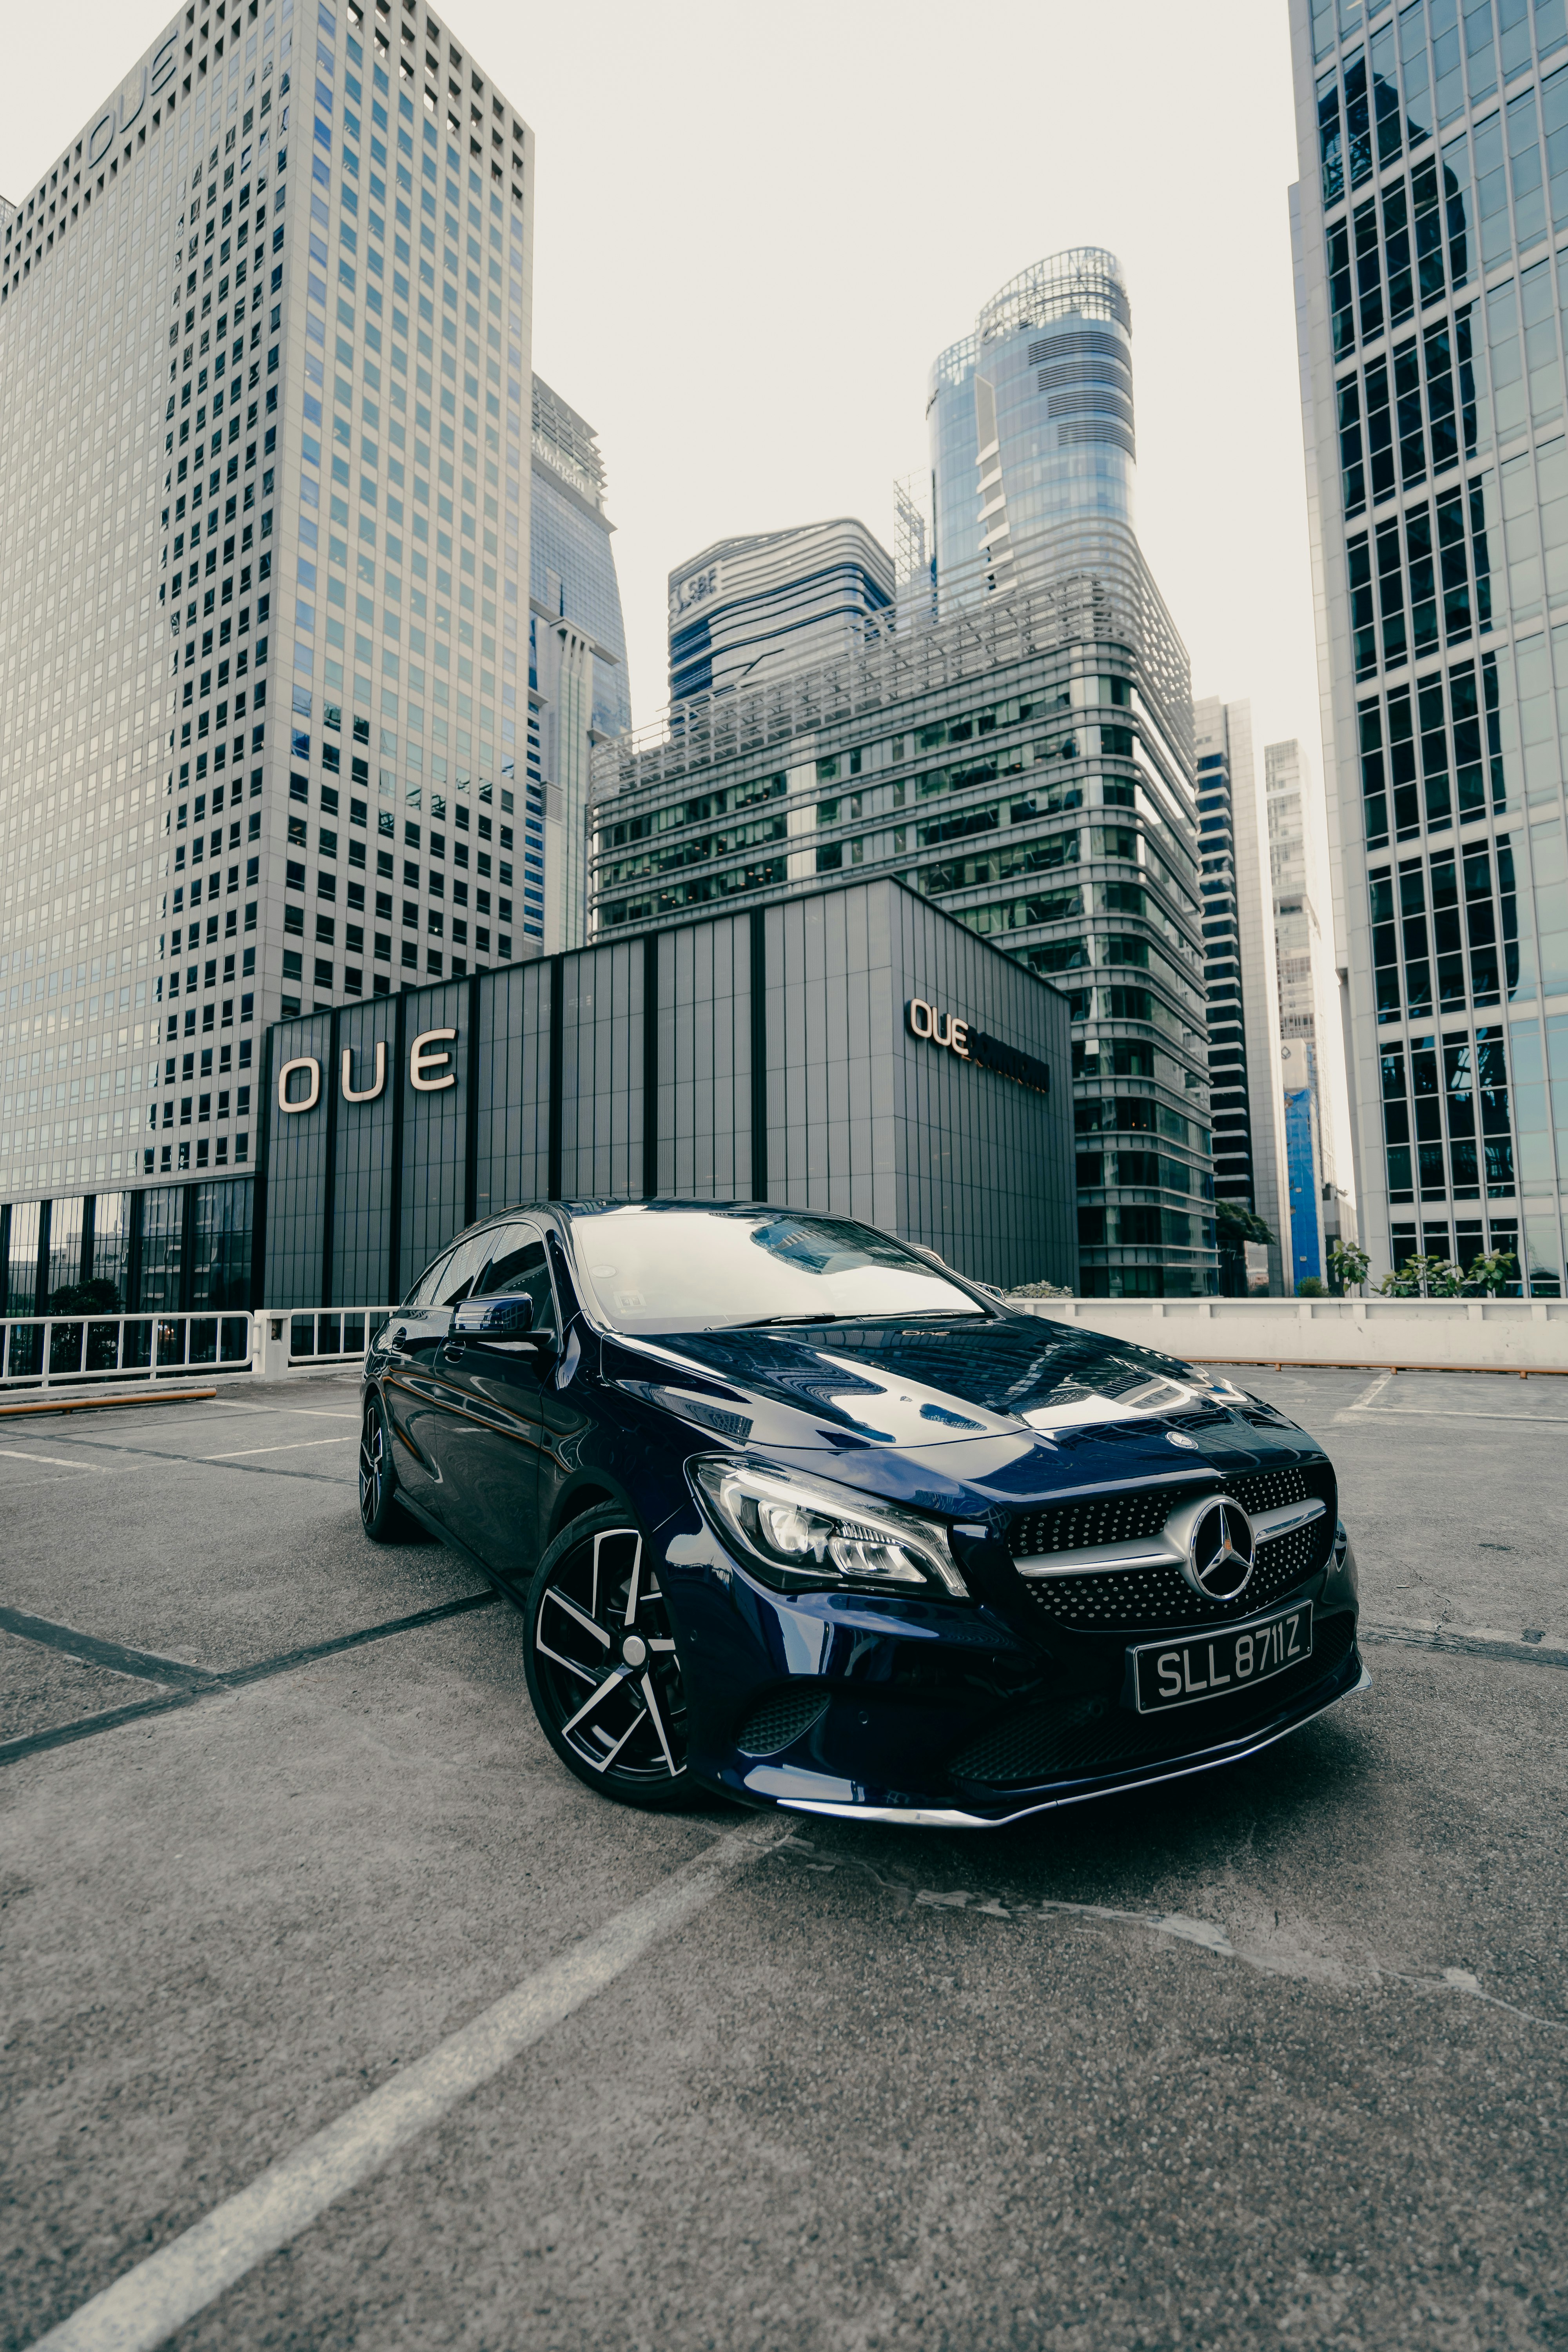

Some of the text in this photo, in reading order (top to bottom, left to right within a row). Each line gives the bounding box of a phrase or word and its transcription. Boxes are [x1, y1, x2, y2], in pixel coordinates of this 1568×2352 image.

[88, 30, 179, 169] OUE
[911, 998, 969, 1055] OUE
[278, 1027, 458, 1113] OUE
